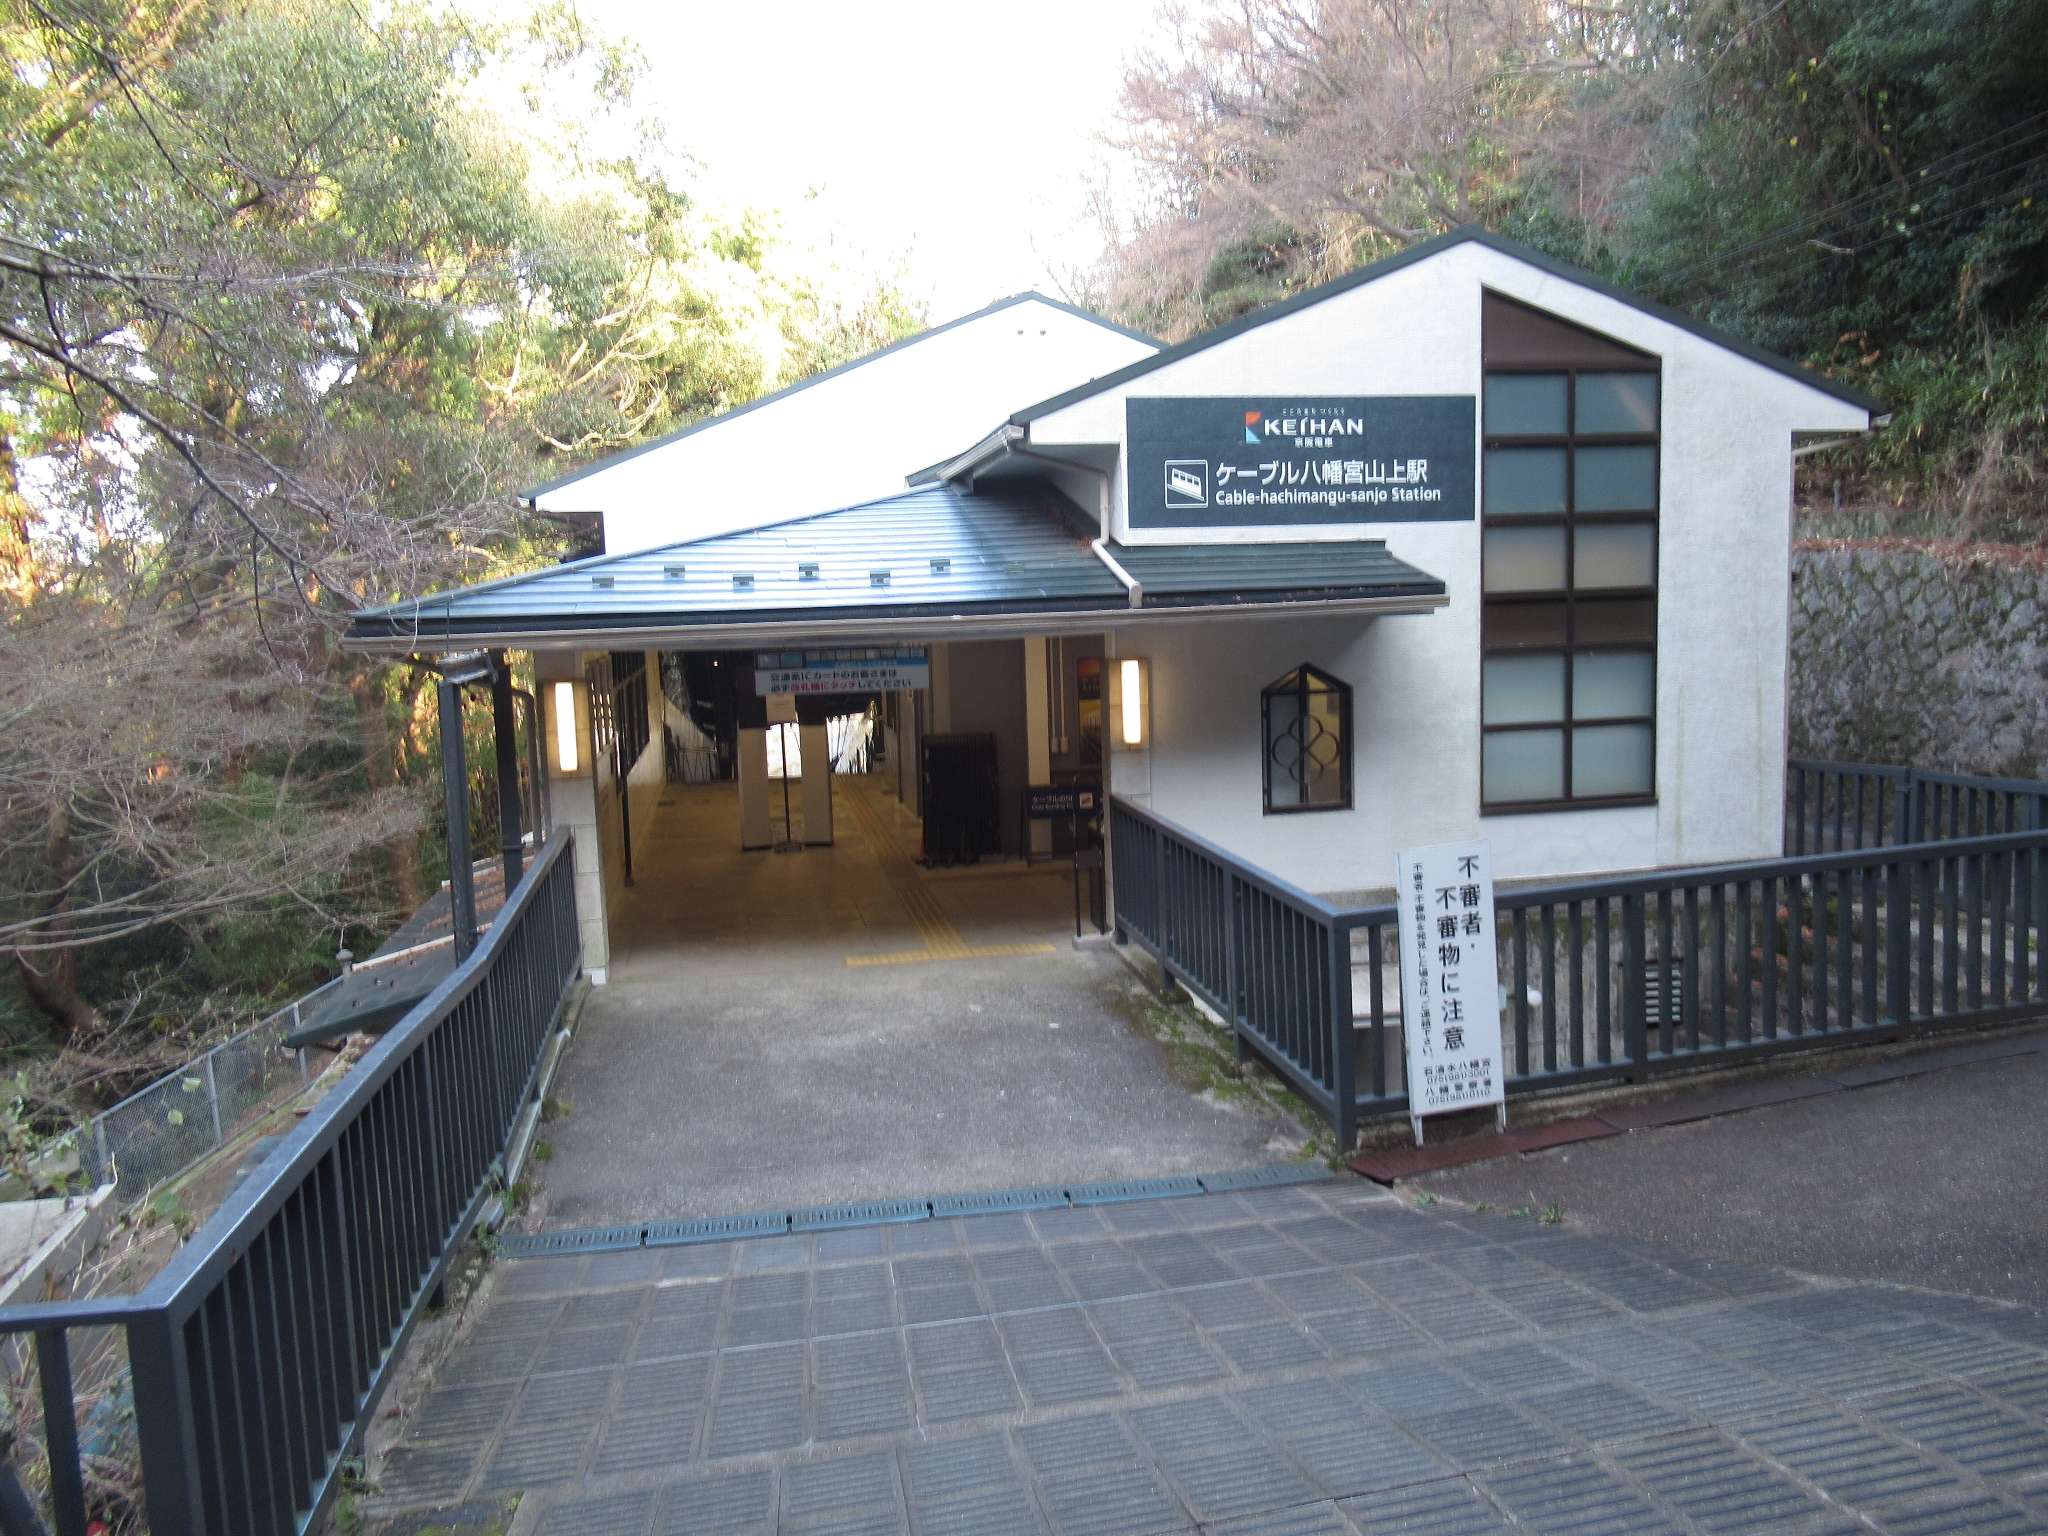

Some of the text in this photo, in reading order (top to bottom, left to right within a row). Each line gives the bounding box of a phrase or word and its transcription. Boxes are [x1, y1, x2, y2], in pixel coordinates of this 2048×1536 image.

[1264, 416, 1364, 436] KEIHAN
[1294, 436, 1334, 448] 京阪電車
[1216, 459, 1428, 486] ケーブル八幡宮山上駅
[1215, 486, 1441, 508] Cable-hachimangu-sanjo Station
[1435, 886, 1465, 1051] 不審物に注意
